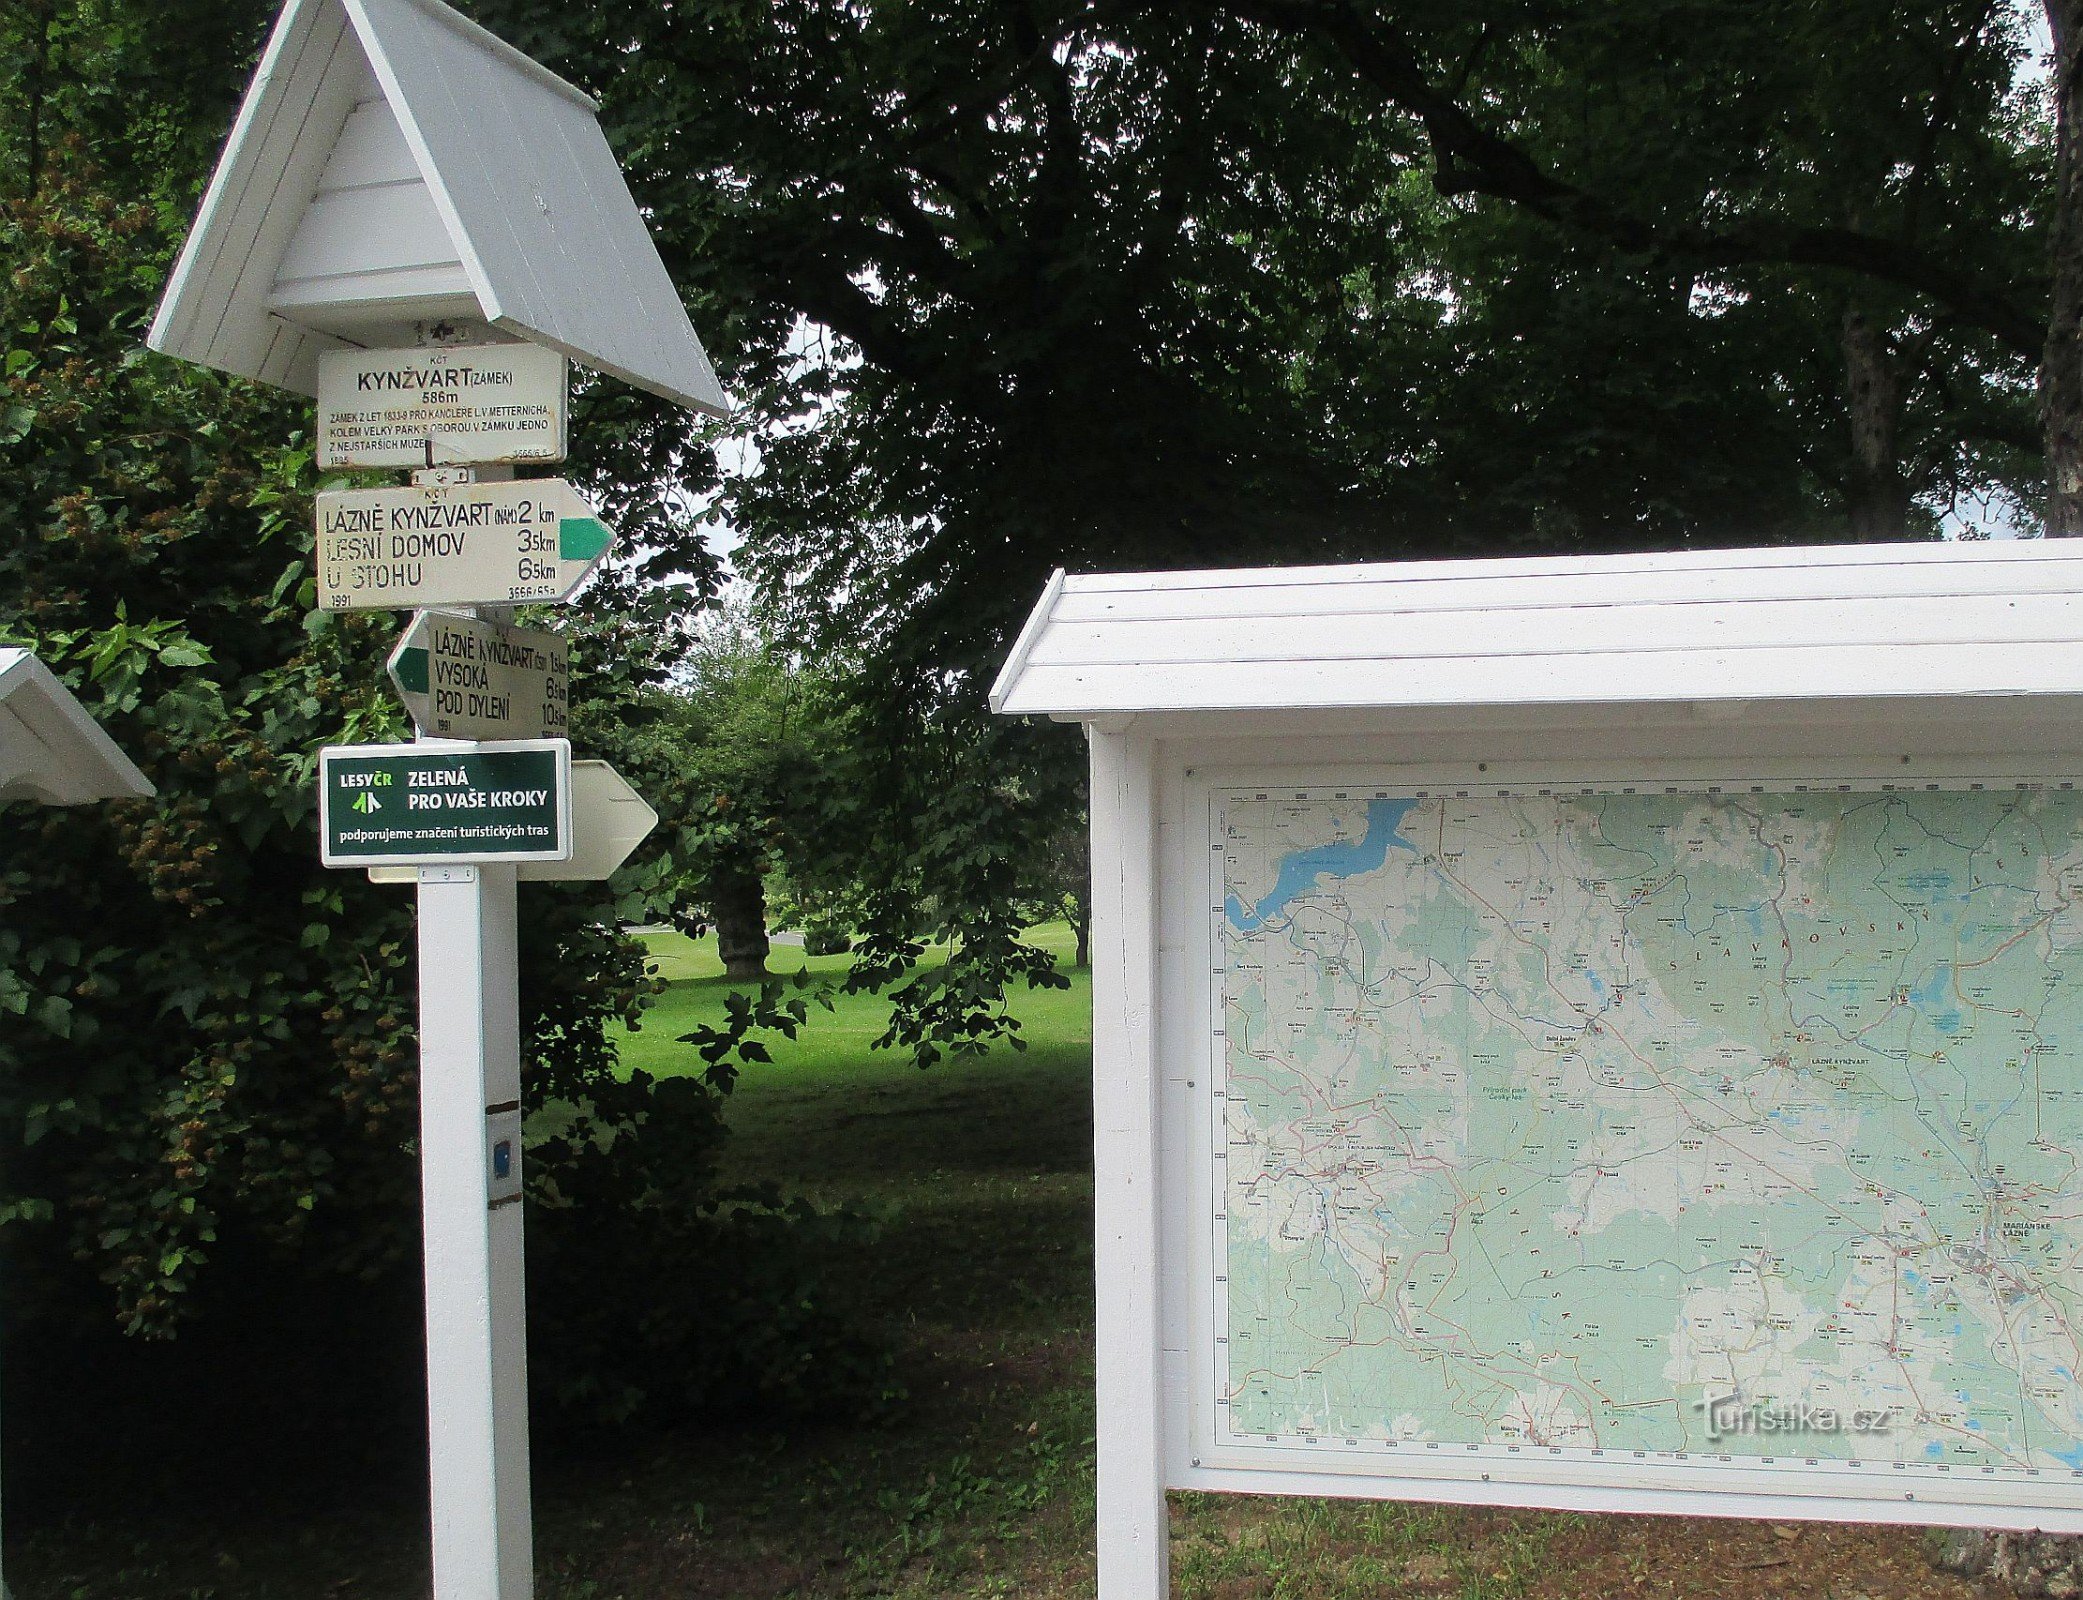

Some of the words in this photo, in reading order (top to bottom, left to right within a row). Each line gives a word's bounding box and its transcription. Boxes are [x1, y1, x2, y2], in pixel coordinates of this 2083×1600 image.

[358, 366, 472, 391] KYNŽVART
[471, 370, 513, 388] (ZÁMEK)
[422, 391, 458, 404] 586m
[330, 411, 358, 423] ZÁMEK
[366, 411, 382, 422] LET
[409, 409, 427, 420] PRO
[330, 427, 361, 438] KOLEM
[364, 424, 393, 436] VELKÝ
[395, 424, 420, 435] PARK
[422, 424, 428, 434] S
[481, 419, 514, 432] ZÁMKU
[516, 420, 548, 431] JEDNO
[329, 442, 335, 452] Z
[337, 439, 398, 452] NEJSTARŠÍCH
[400, 438, 428, 449] MUZE
[326, 503, 383, 533] LÁZNĚ
[391, 501, 493, 530] KYNŽVART
[518, 501, 532, 524] 2
[539, 502, 554, 523] km
[326, 532, 383, 562] LESNÍ
[391, 532, 465, 559] DOMOV
[327, 567, 341, 589] U
[352, 563, 422, 589] STOHU
[331, 594, 351, 607] 1991
[435, 626, 474, 659] LÁZNĚ
[479, 637, 534, 671] KYNŽVART
[435, 660, 489, 691] VYSOKÁ
[436, 689, 462, 715] POD
[469, 692, 511, 721] DYLENÍ
[408, 766, 469, 788] ZELENÁ
[409, 793, 443, 810] PRO
[445, 788, 487, 809] VAŠE
[490, 790, 547, 807] KROKY
[339, 829, 413, 844] podporujeme
[415, 826, 458, 839] značení
[459, 823, 525, 839] turistických
[527, 824, 549, 837] tras
